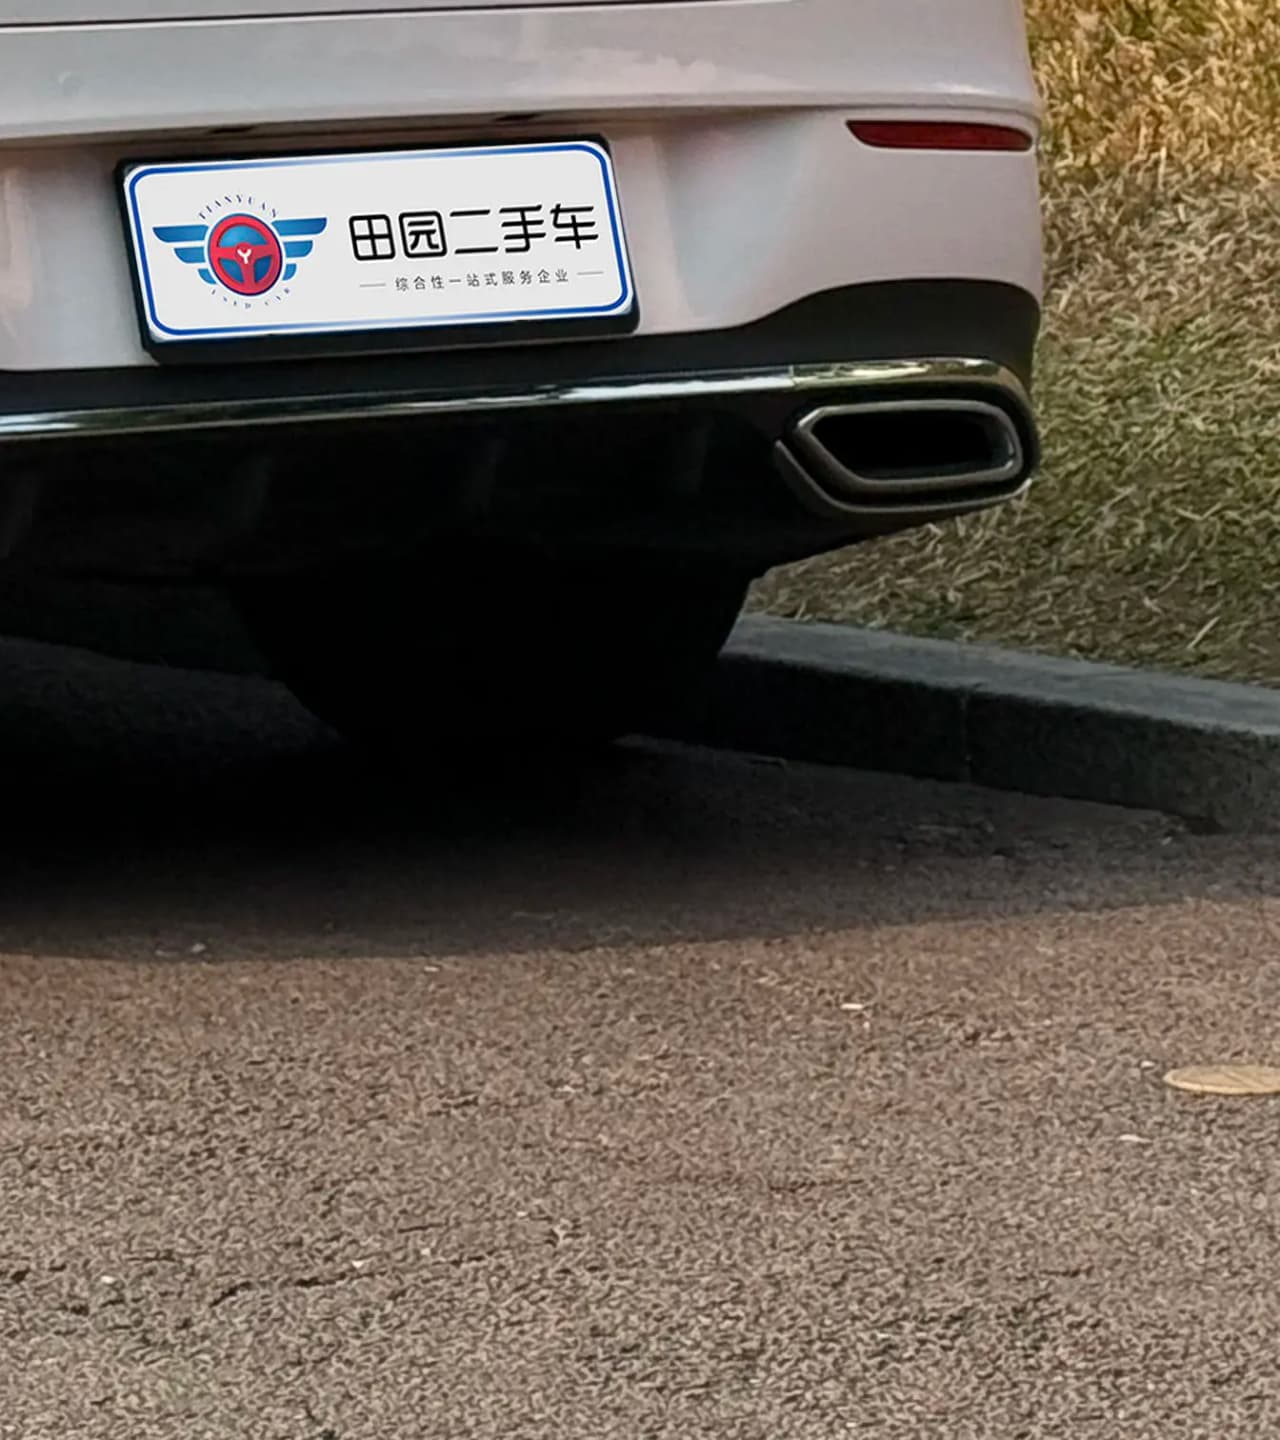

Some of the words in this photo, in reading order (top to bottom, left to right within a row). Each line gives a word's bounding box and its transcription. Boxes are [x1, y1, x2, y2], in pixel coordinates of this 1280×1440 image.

[348, 203, 599, 261] 田园二手车
[394, 268, 569, 292] 综合性一站式服务企业
